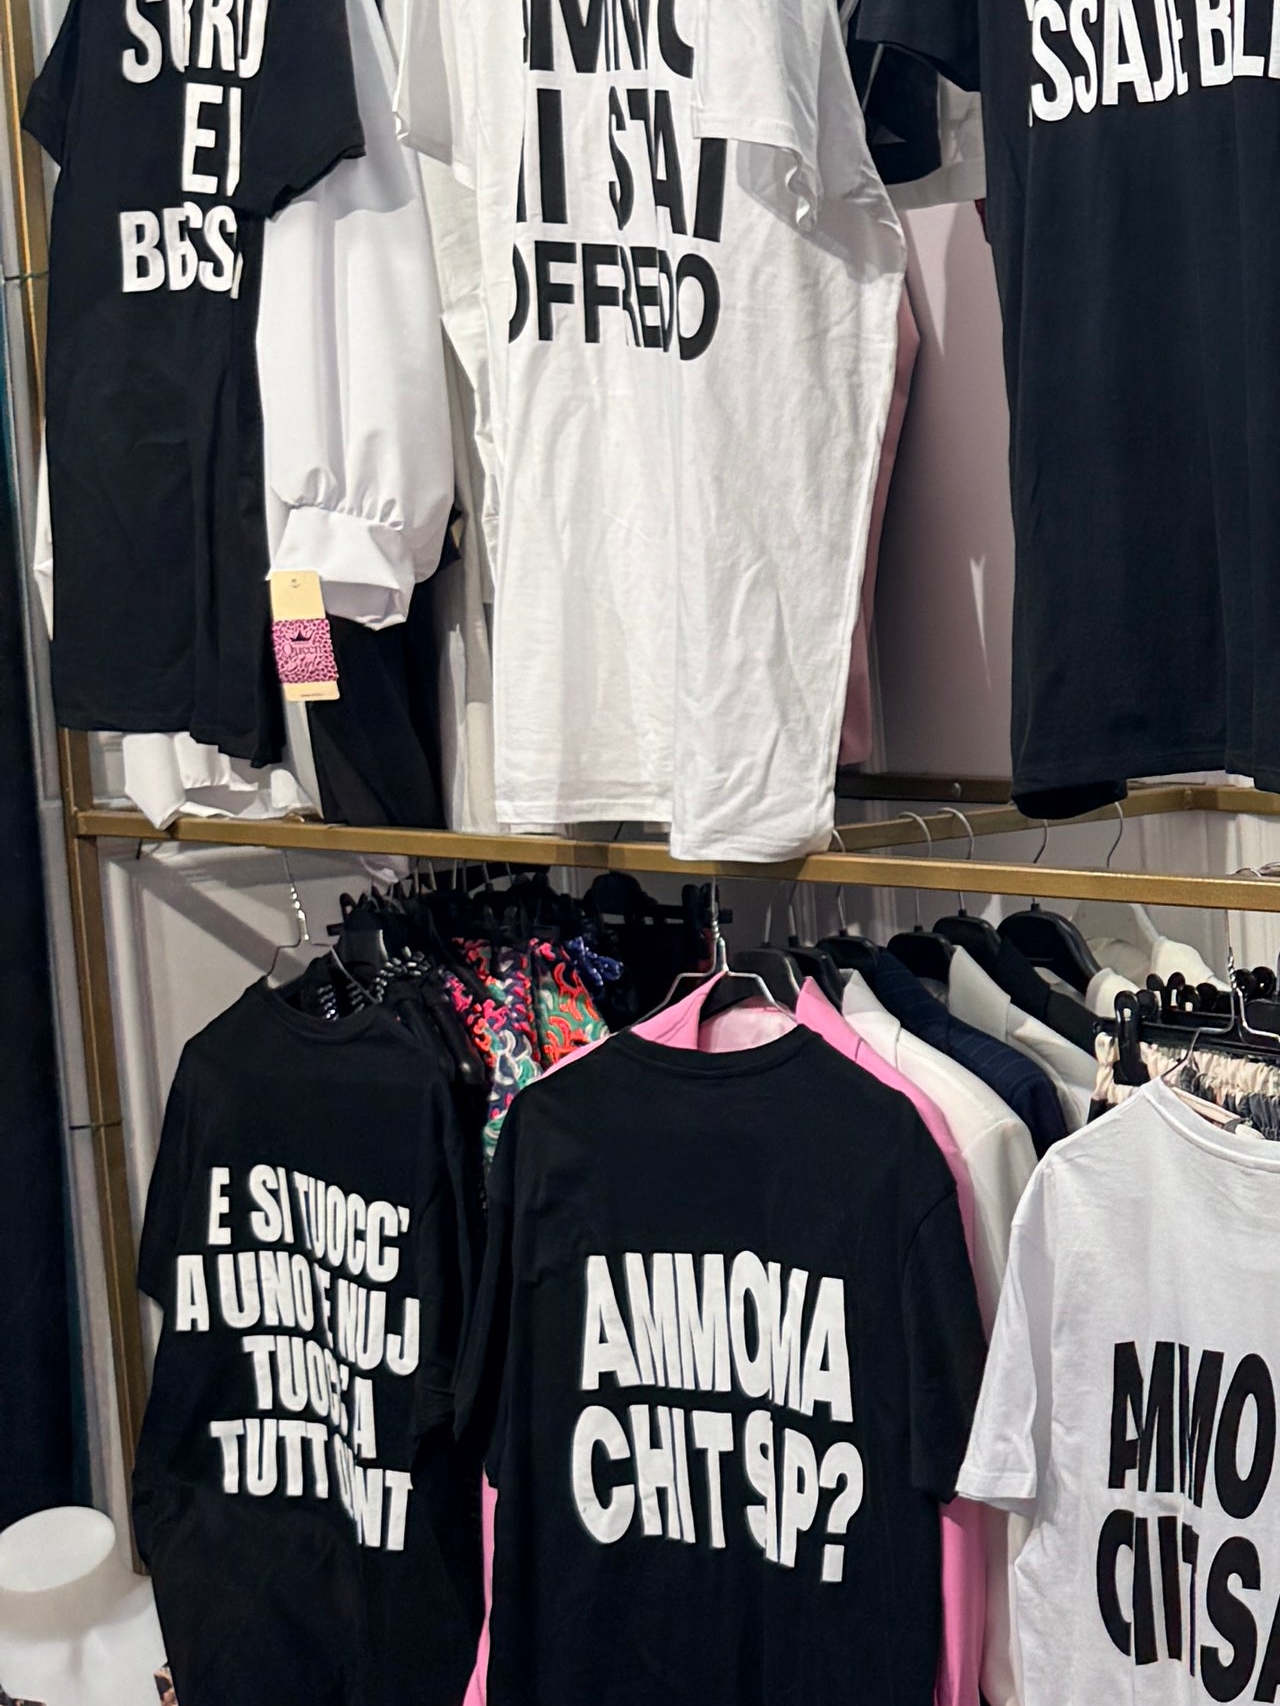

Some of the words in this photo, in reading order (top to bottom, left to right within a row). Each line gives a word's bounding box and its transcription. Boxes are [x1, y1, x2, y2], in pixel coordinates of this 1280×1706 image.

[209, 1167, 231, 1245] E
[249, 1164, 294, 1244] SI
[176, 1254, 209, 1331] A
[218, 1251, 314, 1332] UNO
[353, 1376, 377, 1459] A
[209, 1419, 328, 1499] TUTT
